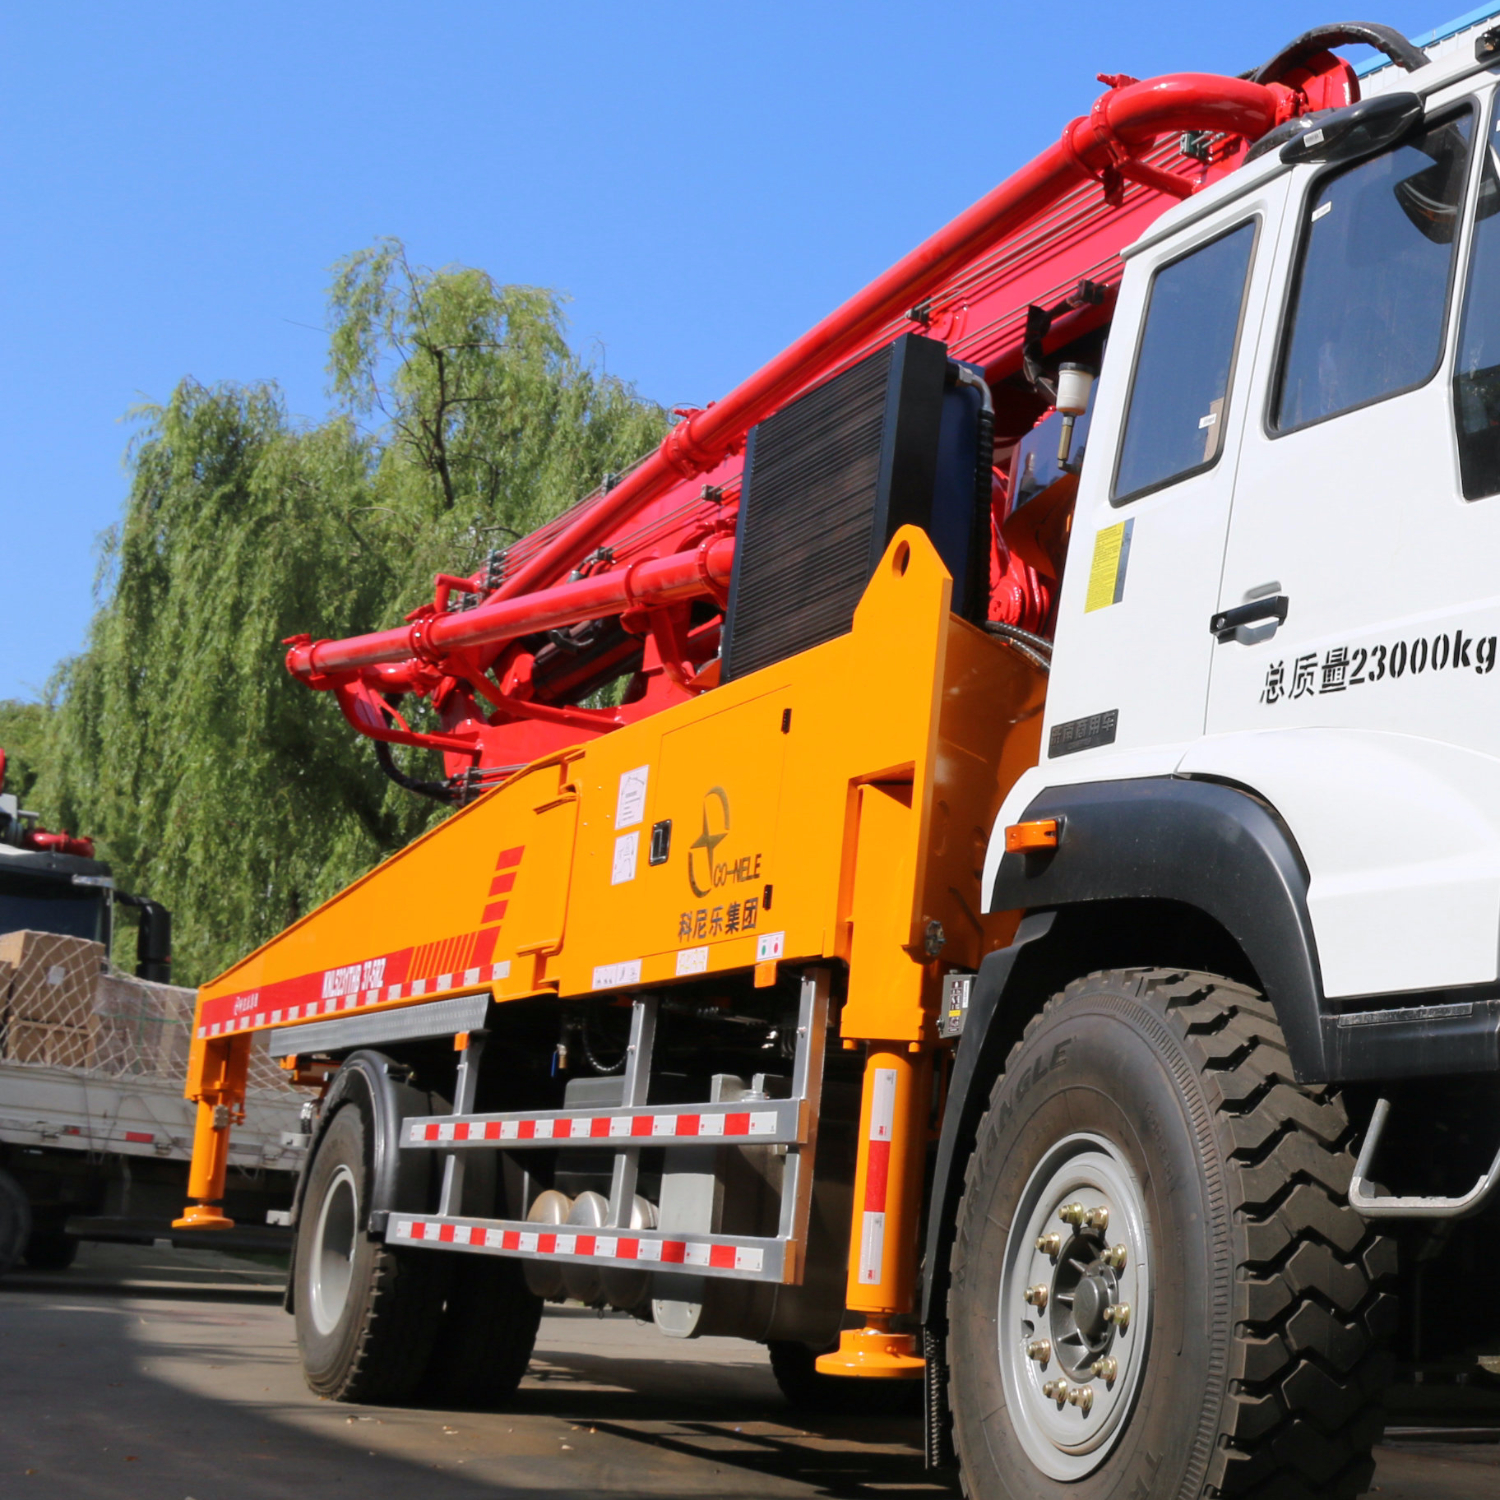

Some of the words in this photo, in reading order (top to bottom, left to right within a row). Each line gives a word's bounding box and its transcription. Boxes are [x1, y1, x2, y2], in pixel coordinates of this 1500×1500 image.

[1260, 630, 1497, 703] 总质量23000kg
[713, 853, 762, 888] CO-NELE
[678, 897, 759, 943] 科尼乐集团
